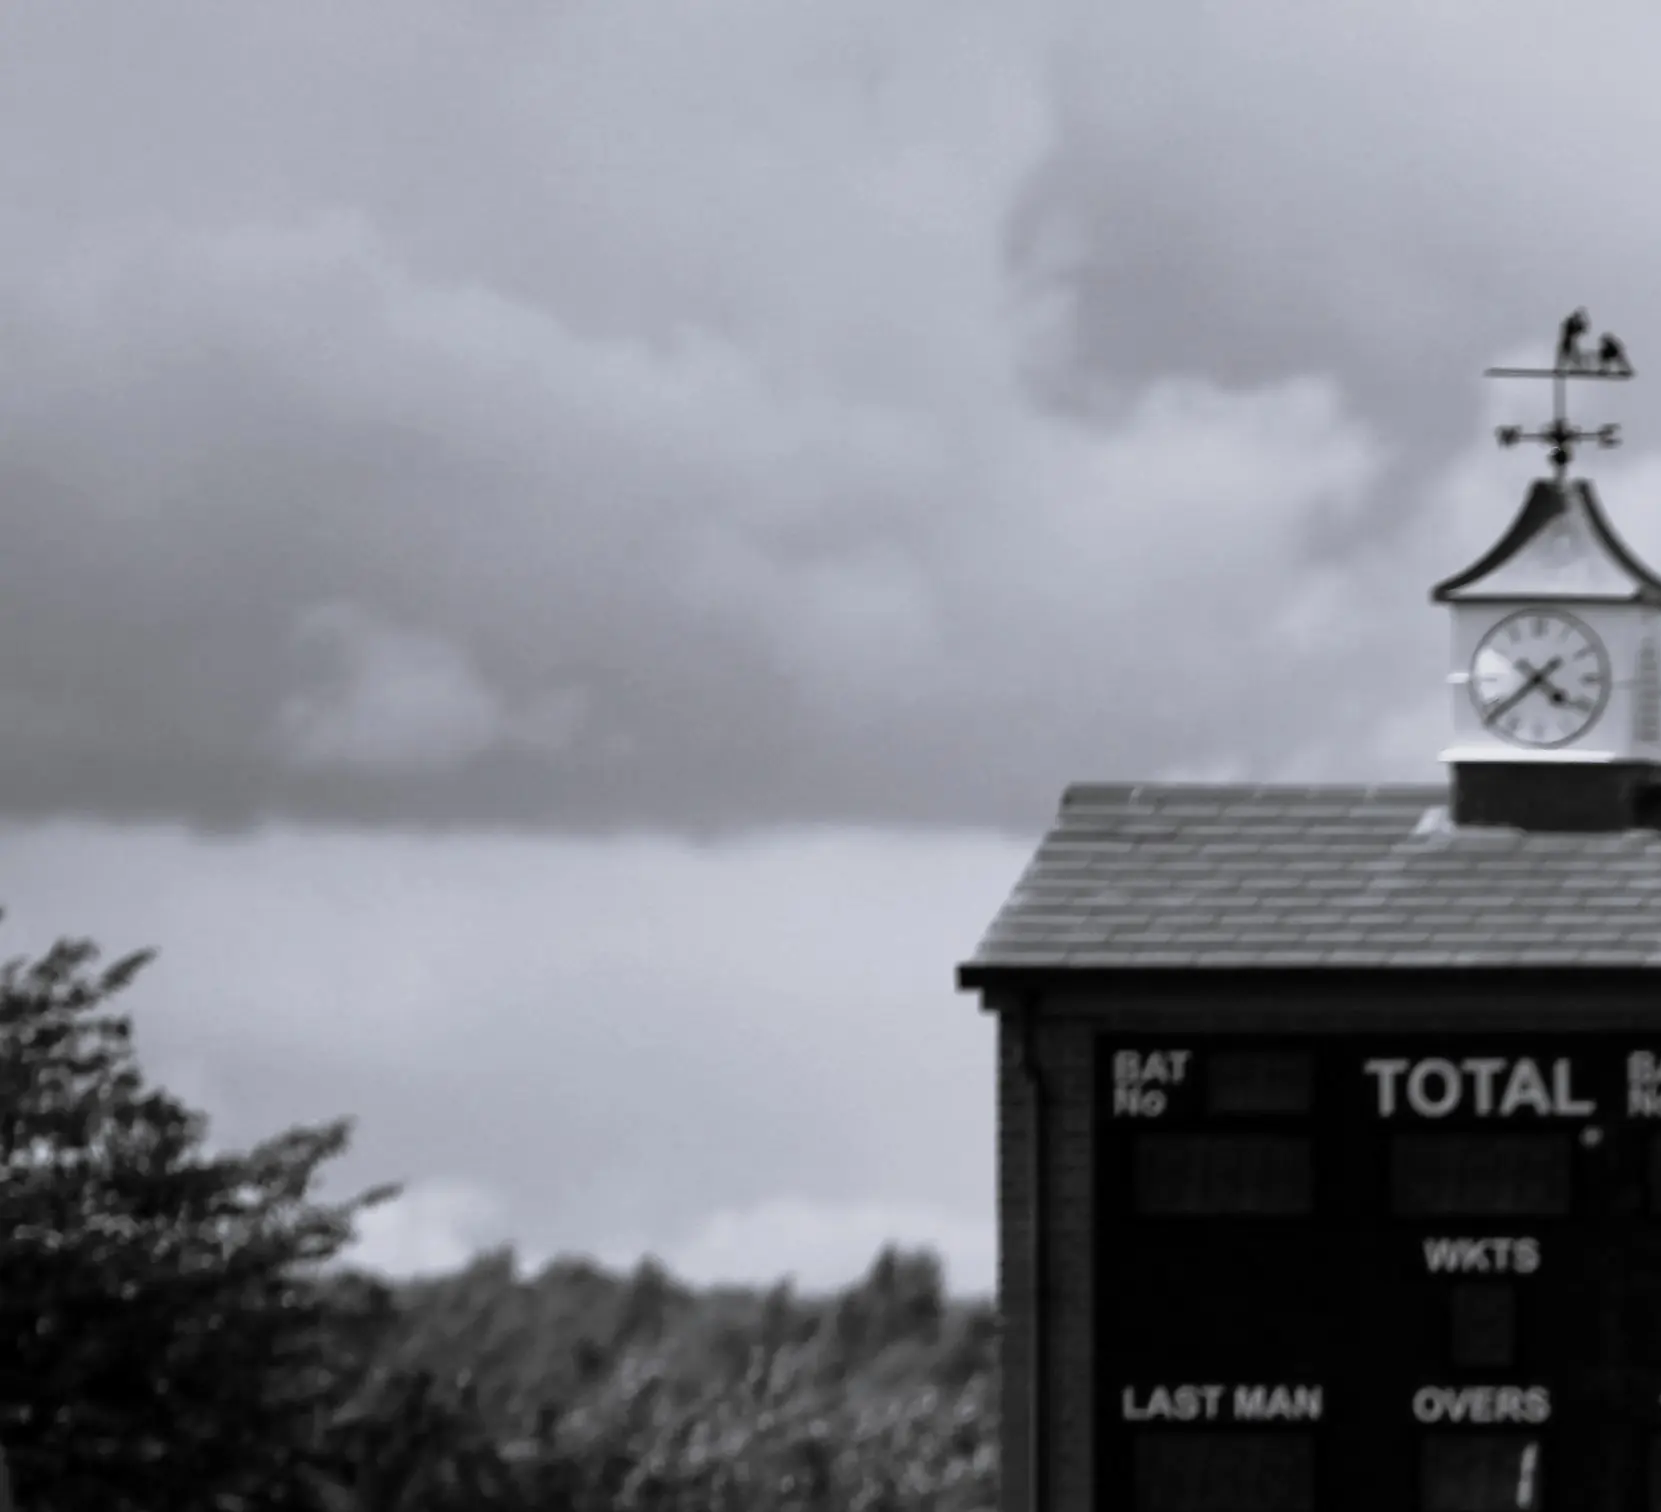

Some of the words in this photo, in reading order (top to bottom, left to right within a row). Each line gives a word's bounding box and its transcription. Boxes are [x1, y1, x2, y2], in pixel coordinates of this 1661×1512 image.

[1113, 1050, 1191, 1083] BAT
[1364, 1058, 1596, 1117] TOTAL
[1424, 1237, 1540, 1273] WKTS
[1122, 1384, 1224, 1420] LAST
[1234, 1385, 1322, 1420] MAN
[1413, 1386, 1551, 1423] OVERS
[1516, 1442, 1538, 1509] 1
